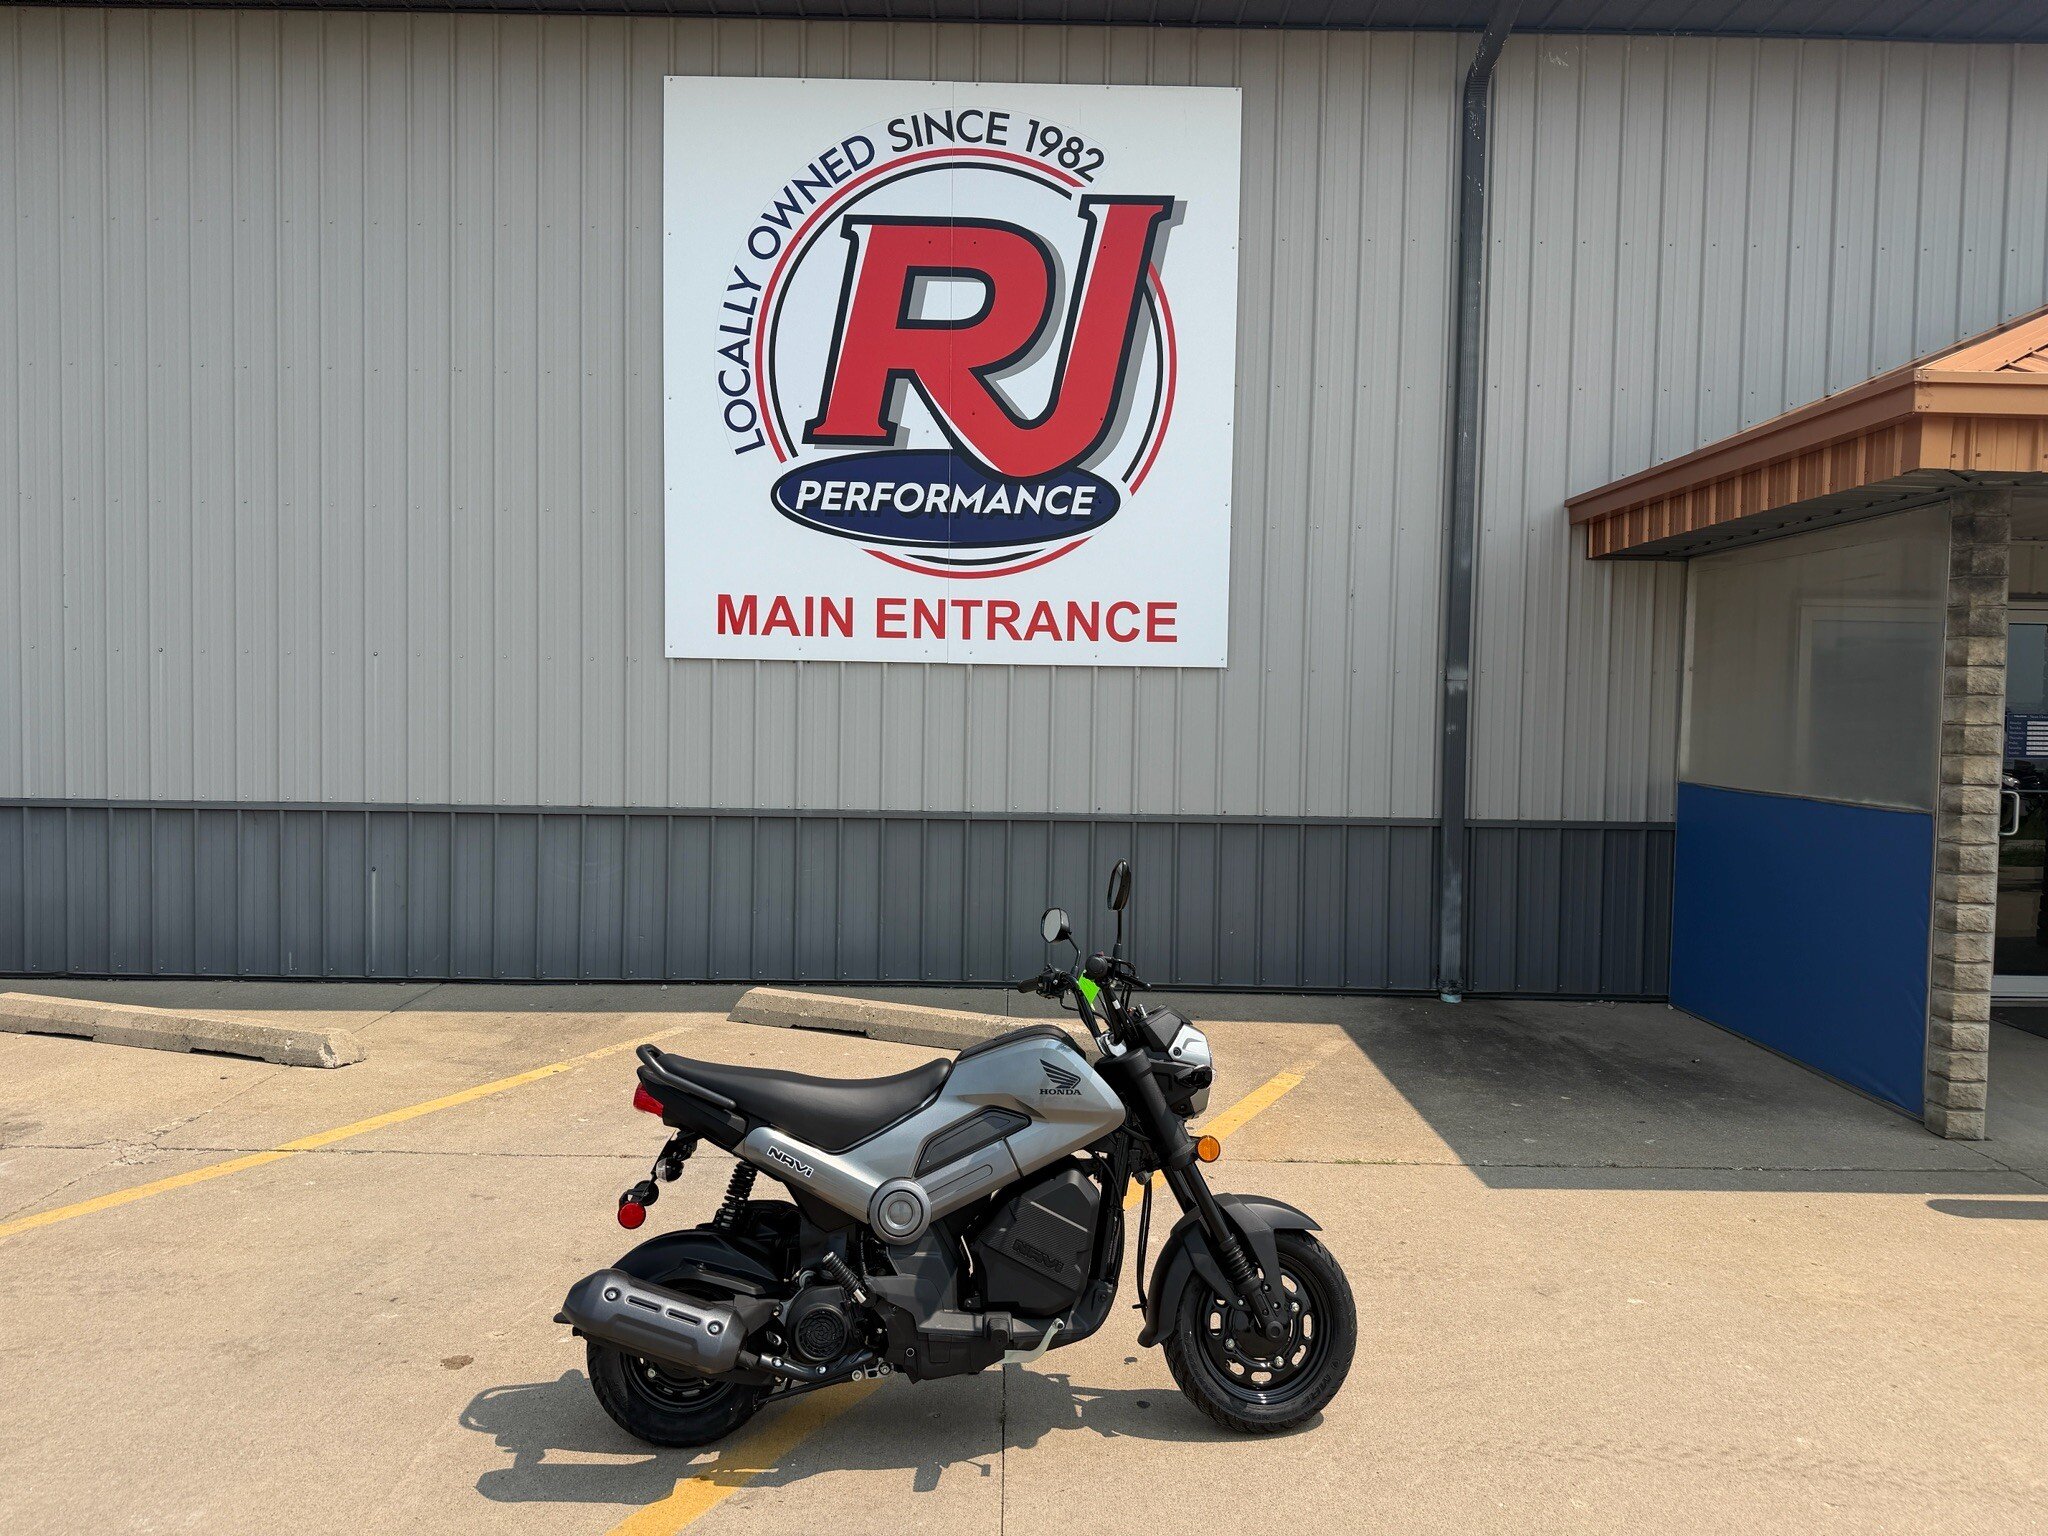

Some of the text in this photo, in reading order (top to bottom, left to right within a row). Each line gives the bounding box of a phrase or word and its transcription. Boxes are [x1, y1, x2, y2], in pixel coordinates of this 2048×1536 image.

[717, 110, 1104, 455] LOCALLY OWNED SINCE 1982
[802, 195, 1176, 477] RJ
[796, 480, 1096, 516] PERFORMANCE
[718, 594, 1177, 643] MAIN ENTRANCE
[1039, 1088, 1082, 1096] HONDA
